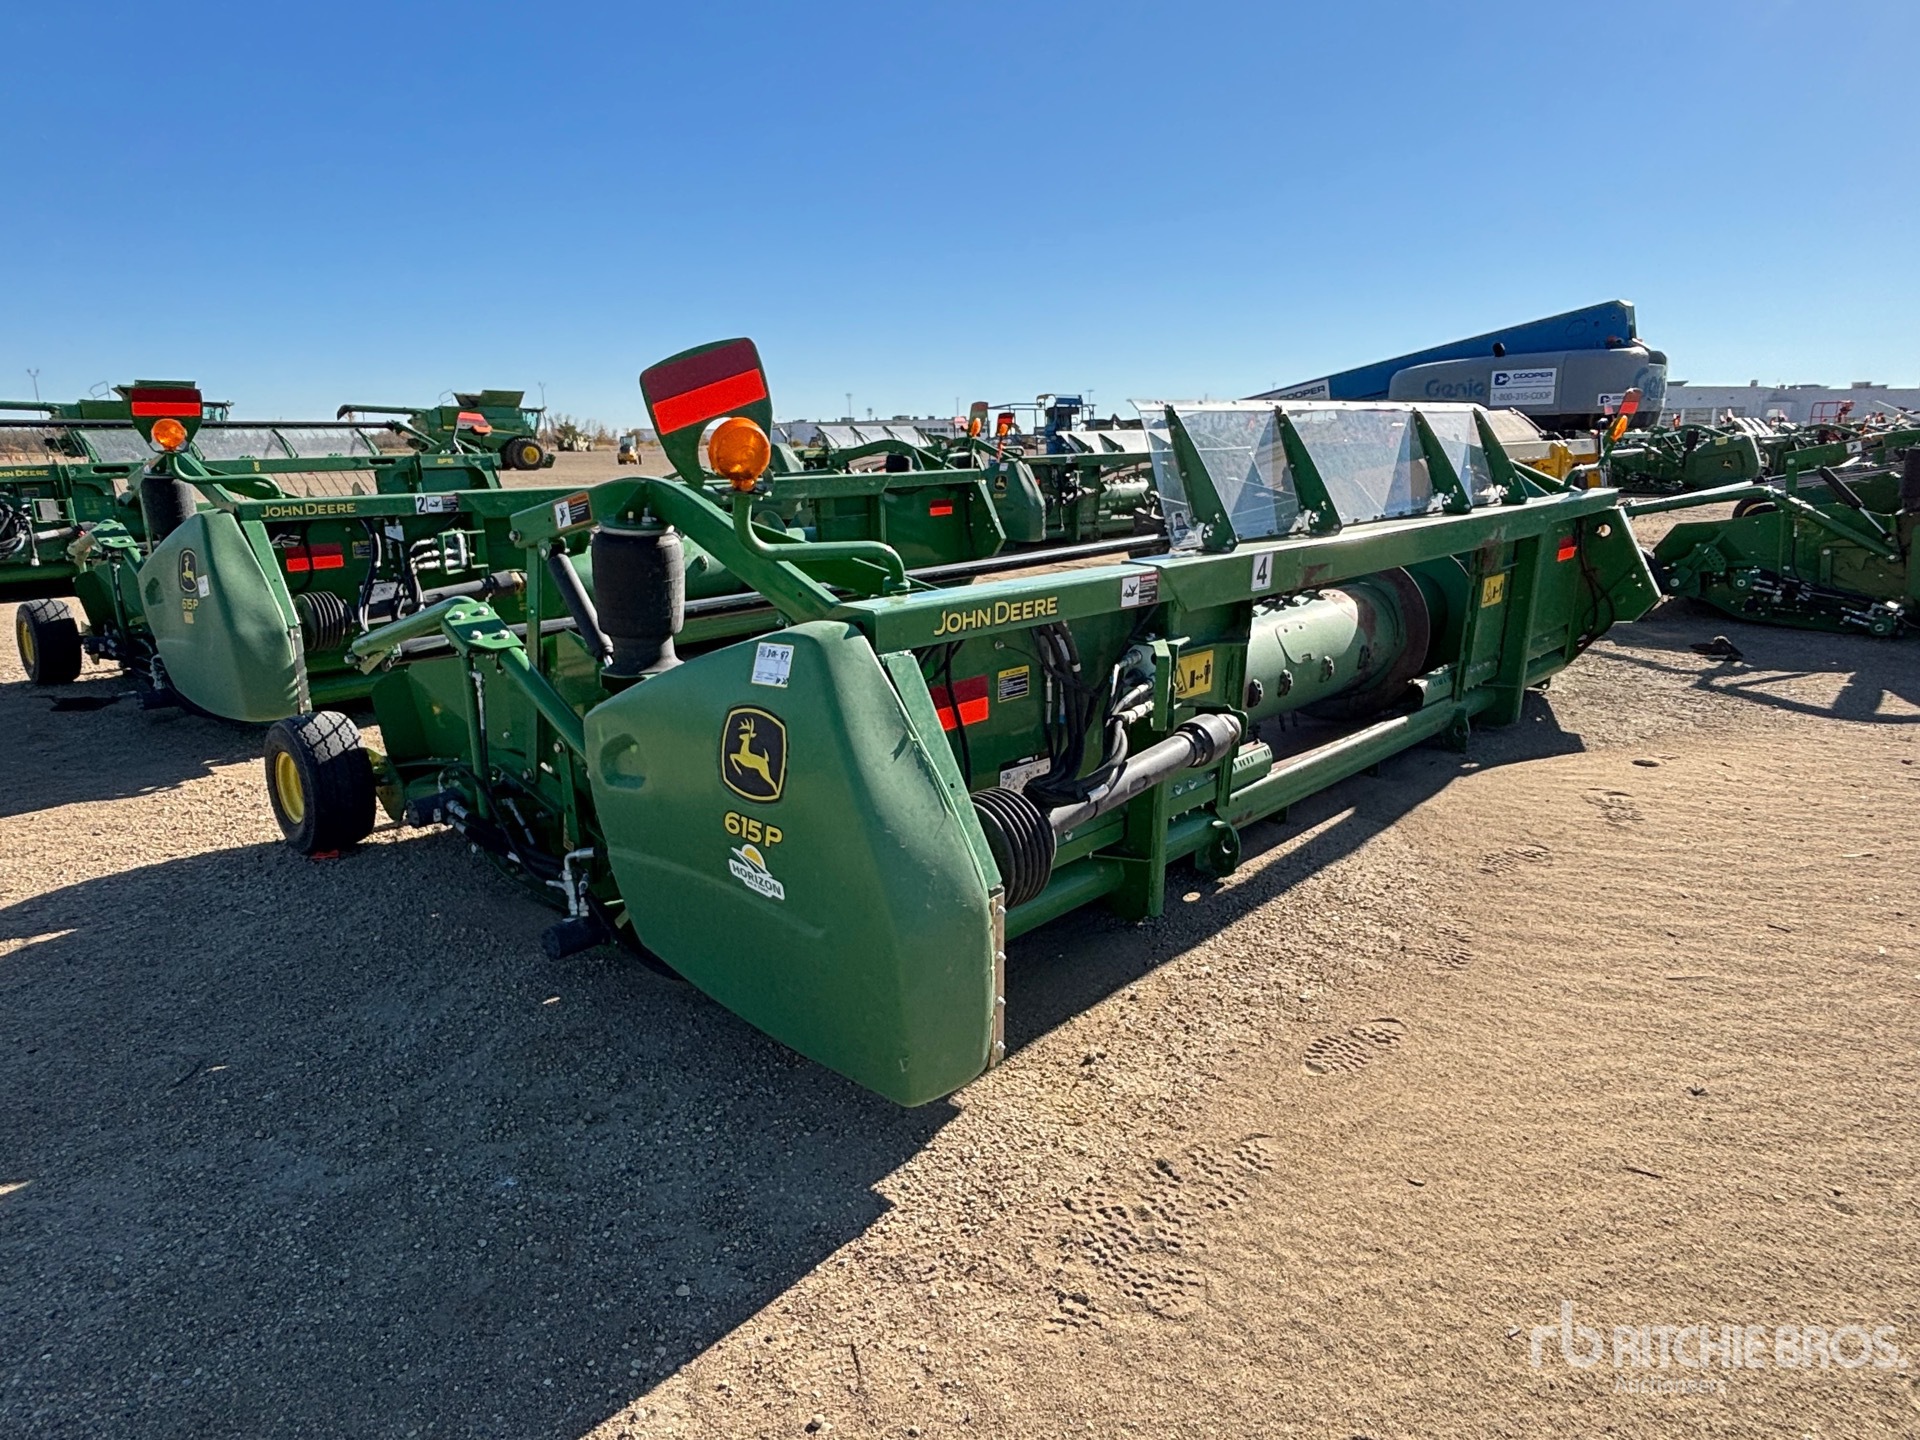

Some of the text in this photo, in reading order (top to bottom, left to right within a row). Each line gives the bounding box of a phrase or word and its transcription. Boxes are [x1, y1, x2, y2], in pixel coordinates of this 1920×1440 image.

[1425, 379, 1485, 397] Genie
[261, 503, 356, 518] JOHN DEERE
[416, 496, 426, 513] 2
[1256, 557, 1268, 584] 4
[933, 596, 1058, 636] JOHN DEERE
[724, 811, 783, 848] 615P
[731, 862, 782, 896] HORIZON
